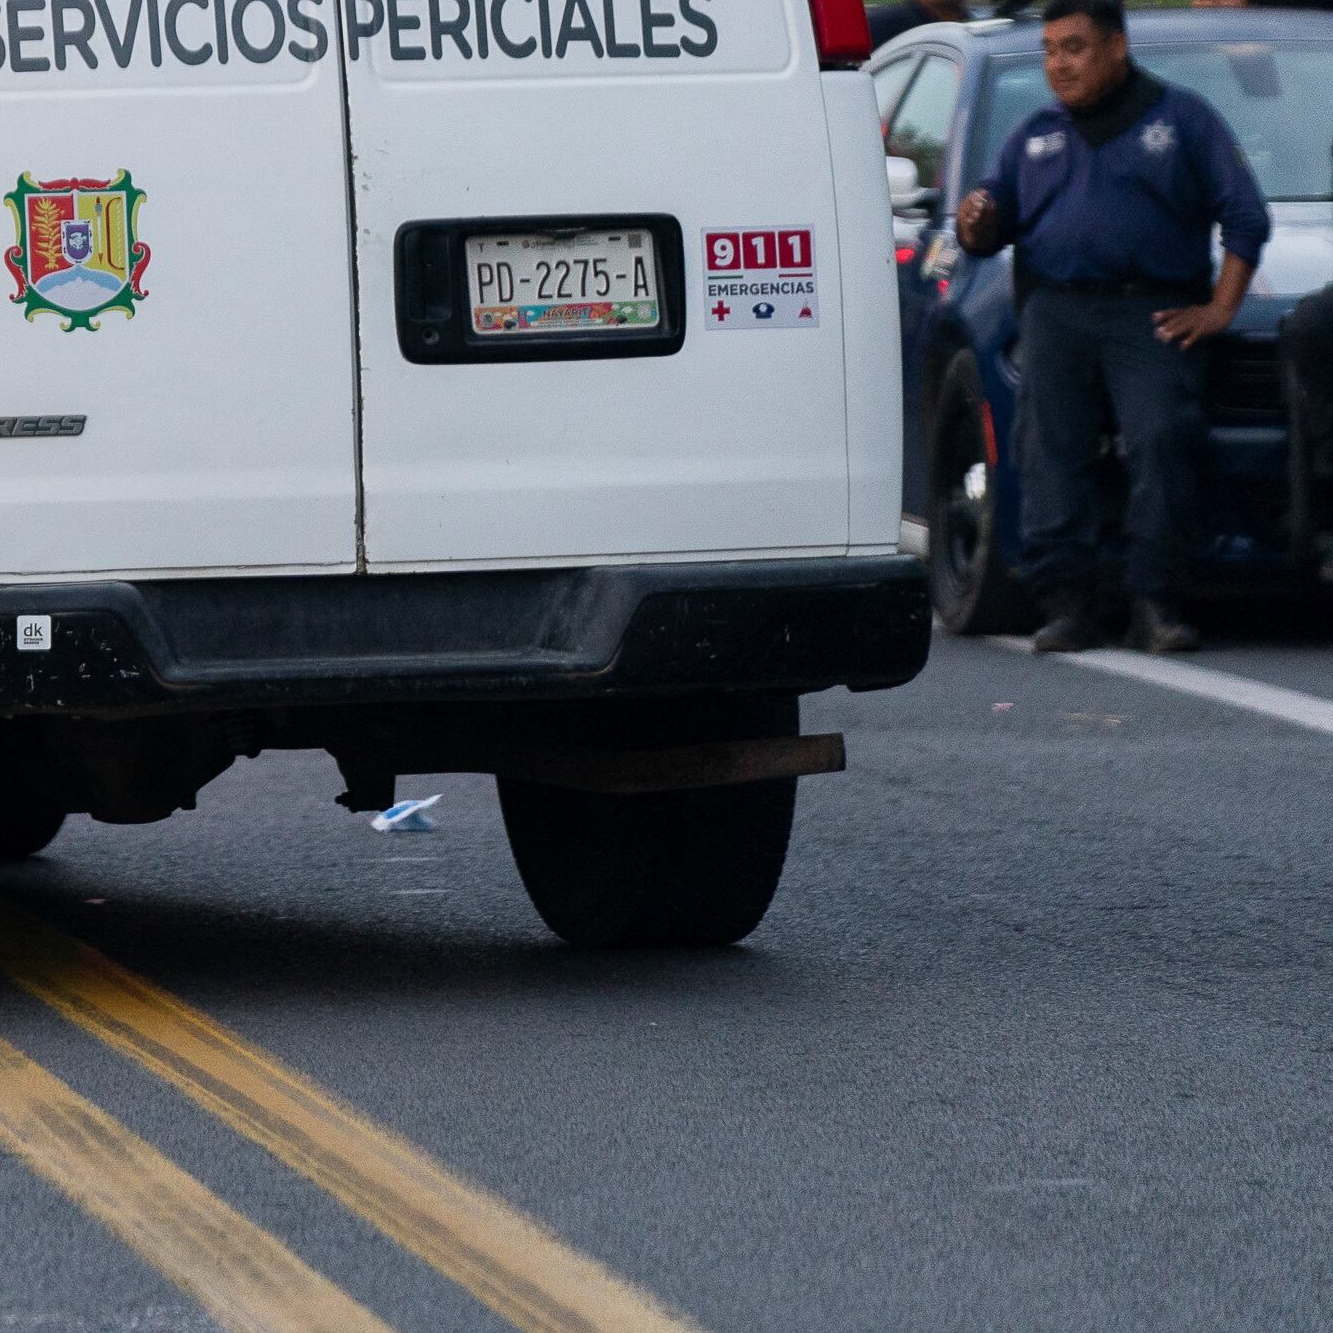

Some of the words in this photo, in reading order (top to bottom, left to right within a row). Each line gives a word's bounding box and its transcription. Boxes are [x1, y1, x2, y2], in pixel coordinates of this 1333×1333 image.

[713, 234, 803, 266] 911
[477, 256, 650, 304] PD-2275-A
[708, 281, 815, 297] EMERGENCIAS
[23, 622, 44, 637] dk
